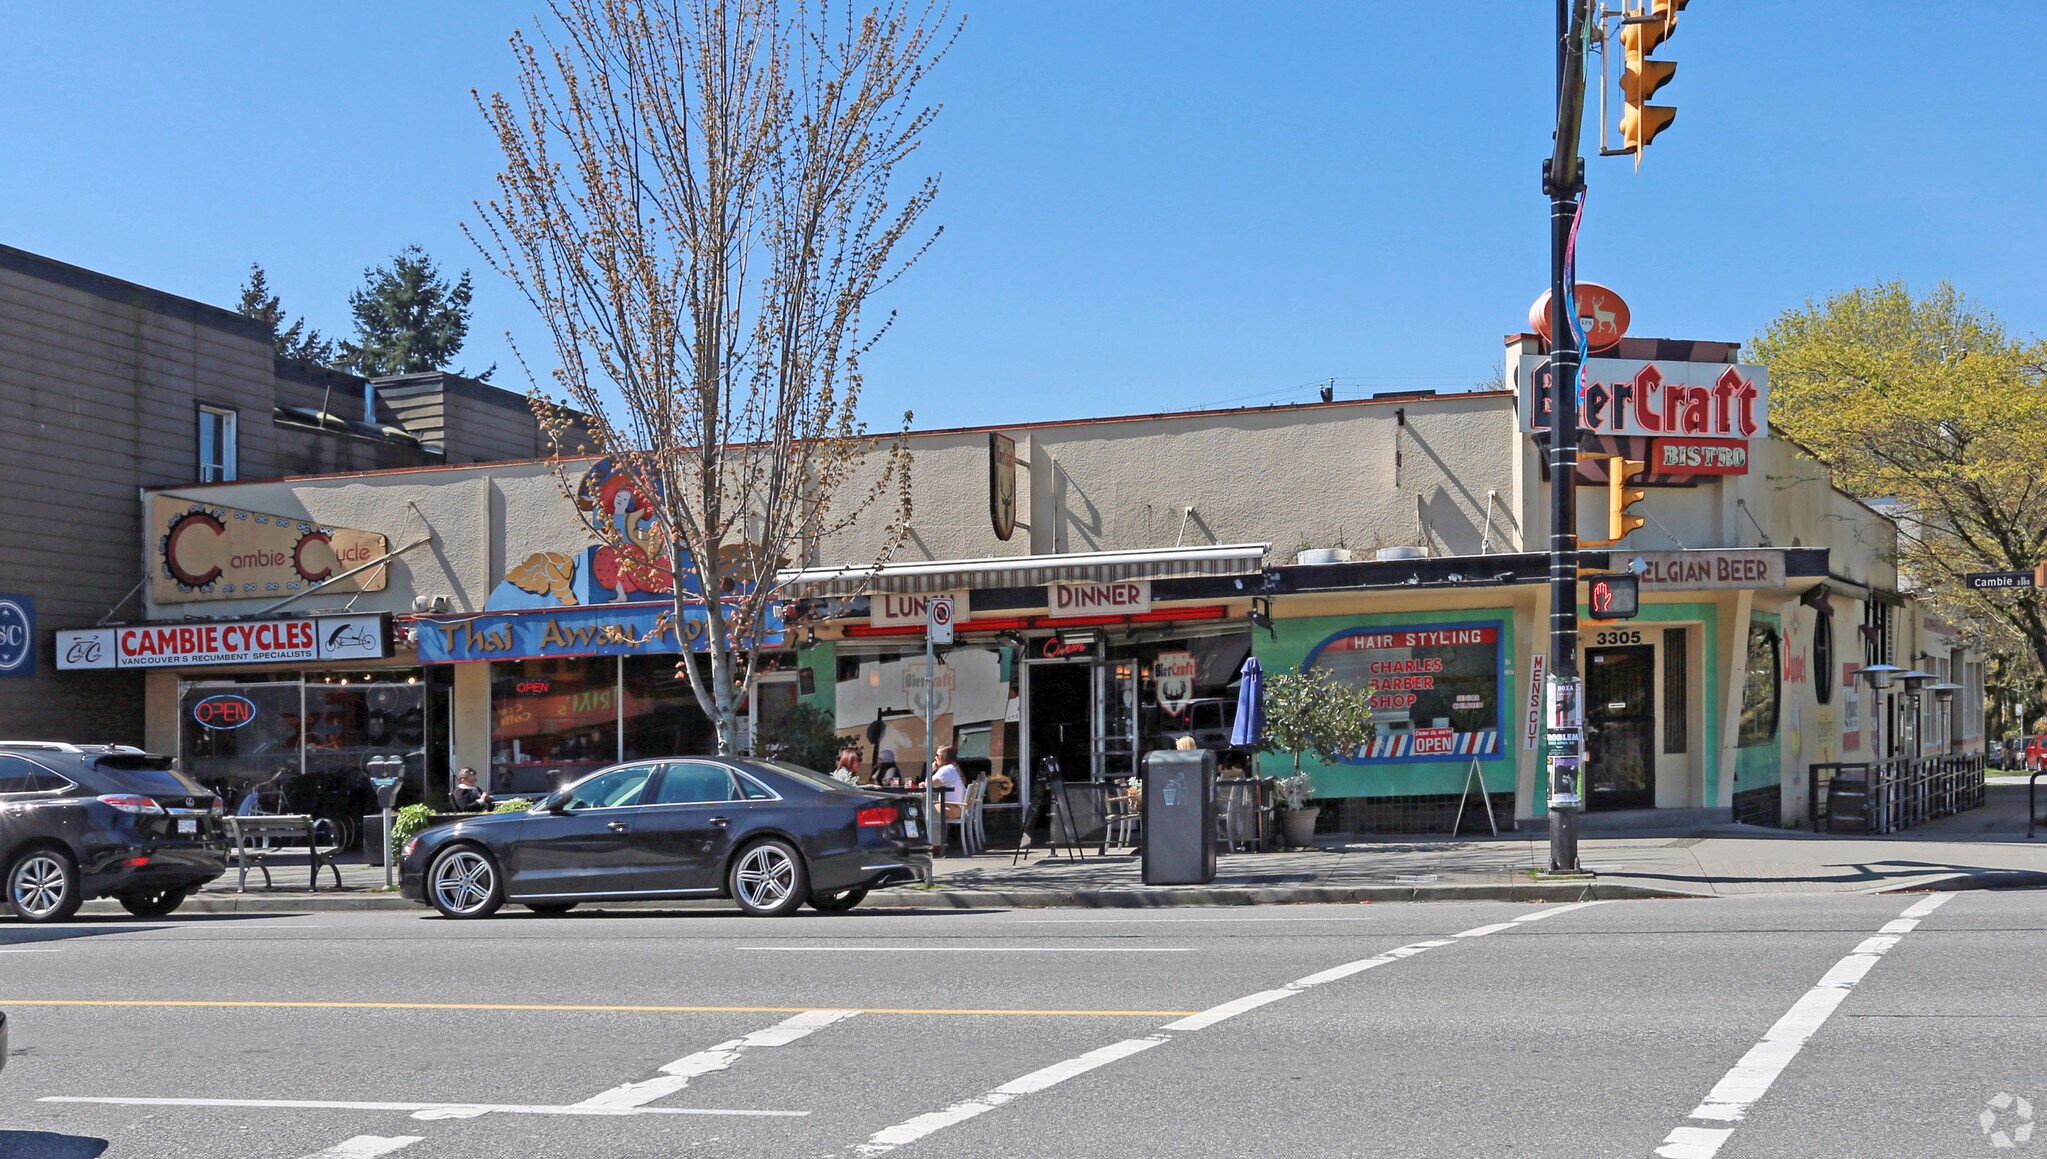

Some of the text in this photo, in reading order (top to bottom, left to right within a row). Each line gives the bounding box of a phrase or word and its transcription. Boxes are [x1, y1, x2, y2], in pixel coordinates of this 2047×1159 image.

[1531, 358, 1760, 437] BerCraft
[1663, 445, 1746, 467] BISTRO
[1717, 557, 1767, 582] BEER
[1974, 577, 2013, 587] Cambie
[1057, 584, 1141, 609] DINNER
[885, 593, 955, 619] LUN
[121, 622, 313, 657] CAMBIE CYCLES
[438, 620, 513, 654] Thai
[1354, 630, 1481, 649] HAIR STYLING
[1596, 631, 1641, 645] 3305
[122, 650, 312, 665] VANCOUVER'S RECUMBENT SPECIALISTS
[1369, 658, 1443, 675] CHARLES
[1155, 660, 1193, 678] BierCraft
[516, 682, 549, 694] OPEN
[905, 673, 952, 688] Bierraft
[1369, 676, 1434, 691] BARBER
[1369, 694, 1417, 709] SHOP
[1528, 656, 1543, 748] MENS CUT
[196, 702, 248, 722] OPEN
[1416, 737, 1452, 752] OPEN
